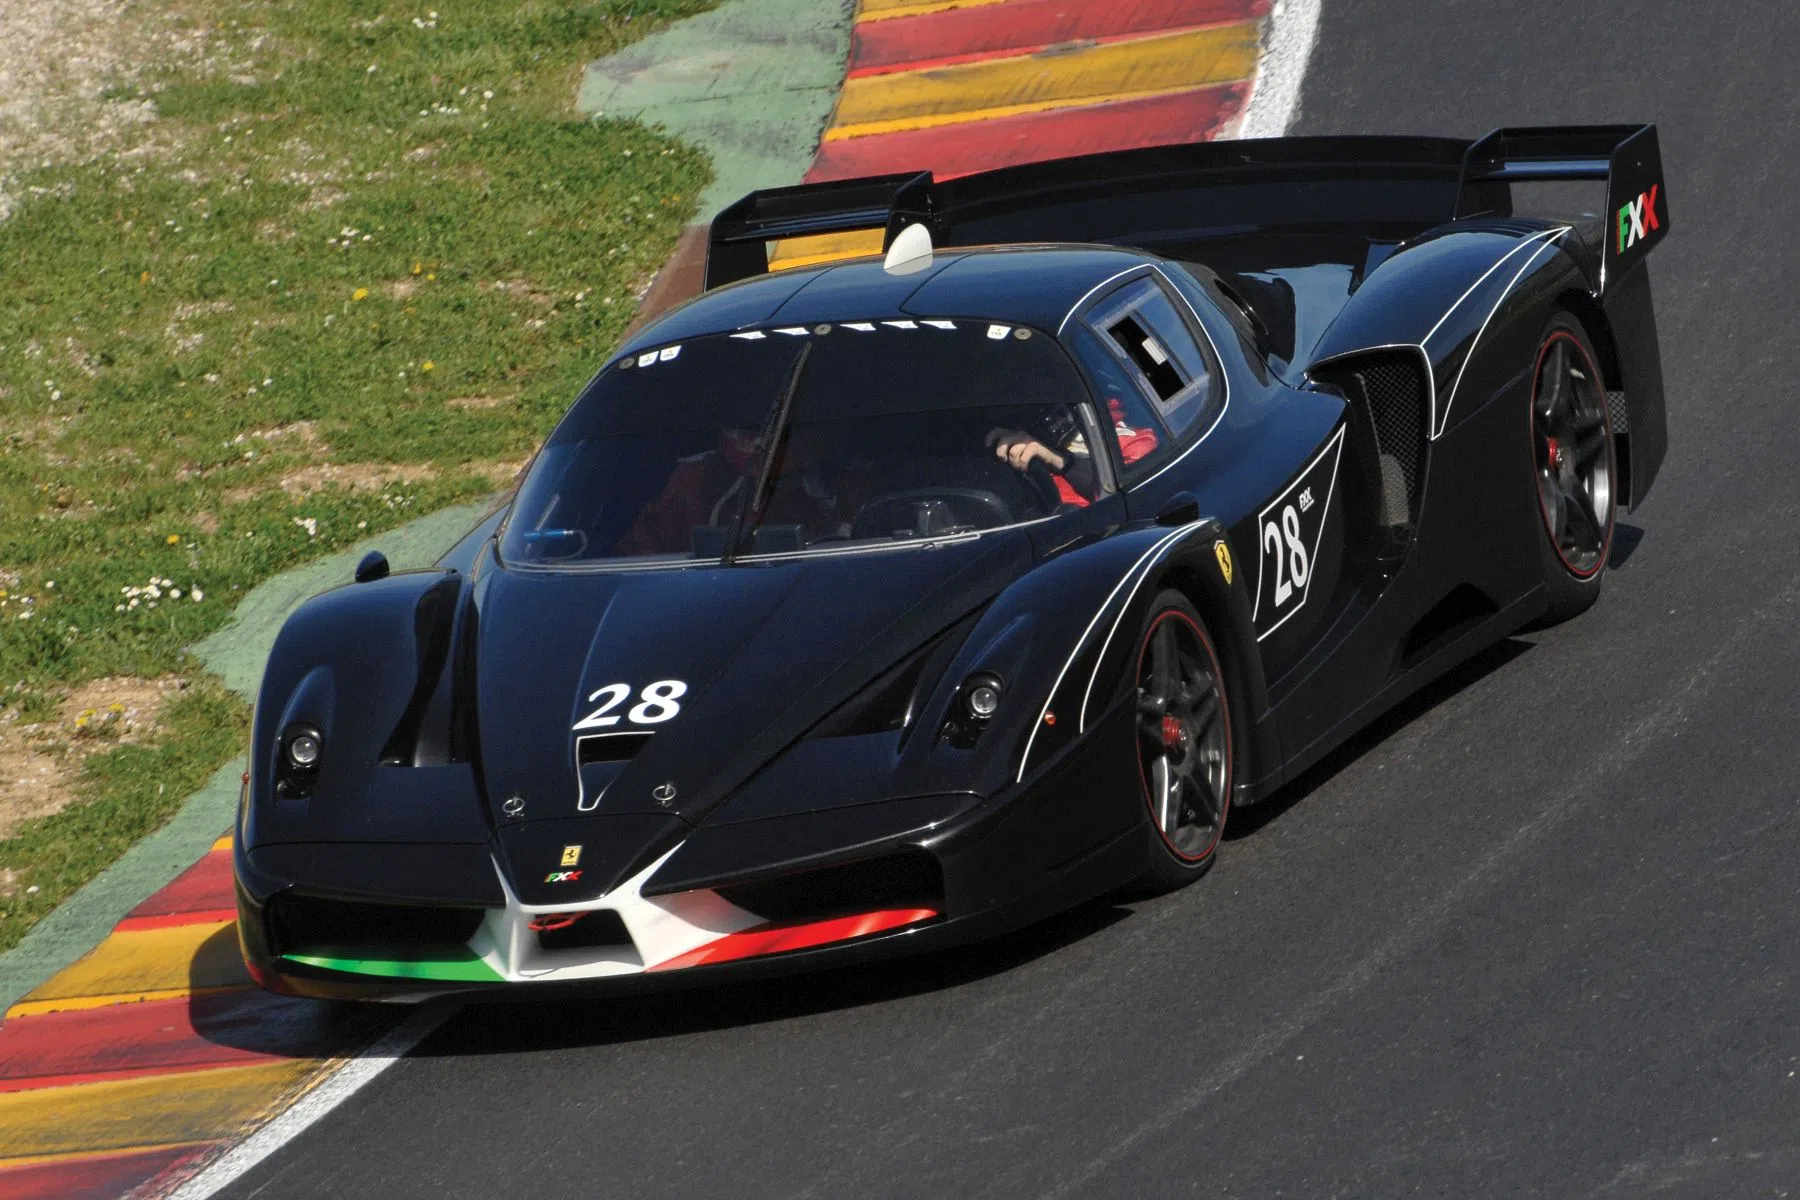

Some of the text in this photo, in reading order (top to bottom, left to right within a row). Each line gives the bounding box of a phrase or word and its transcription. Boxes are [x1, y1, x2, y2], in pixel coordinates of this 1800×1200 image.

[1617, 184, 1659, 254] FXX
[1265, 505, 1308, 607] 28
[572, 680, 687, 730] 28
[544, 871, 584, 882] FXX
